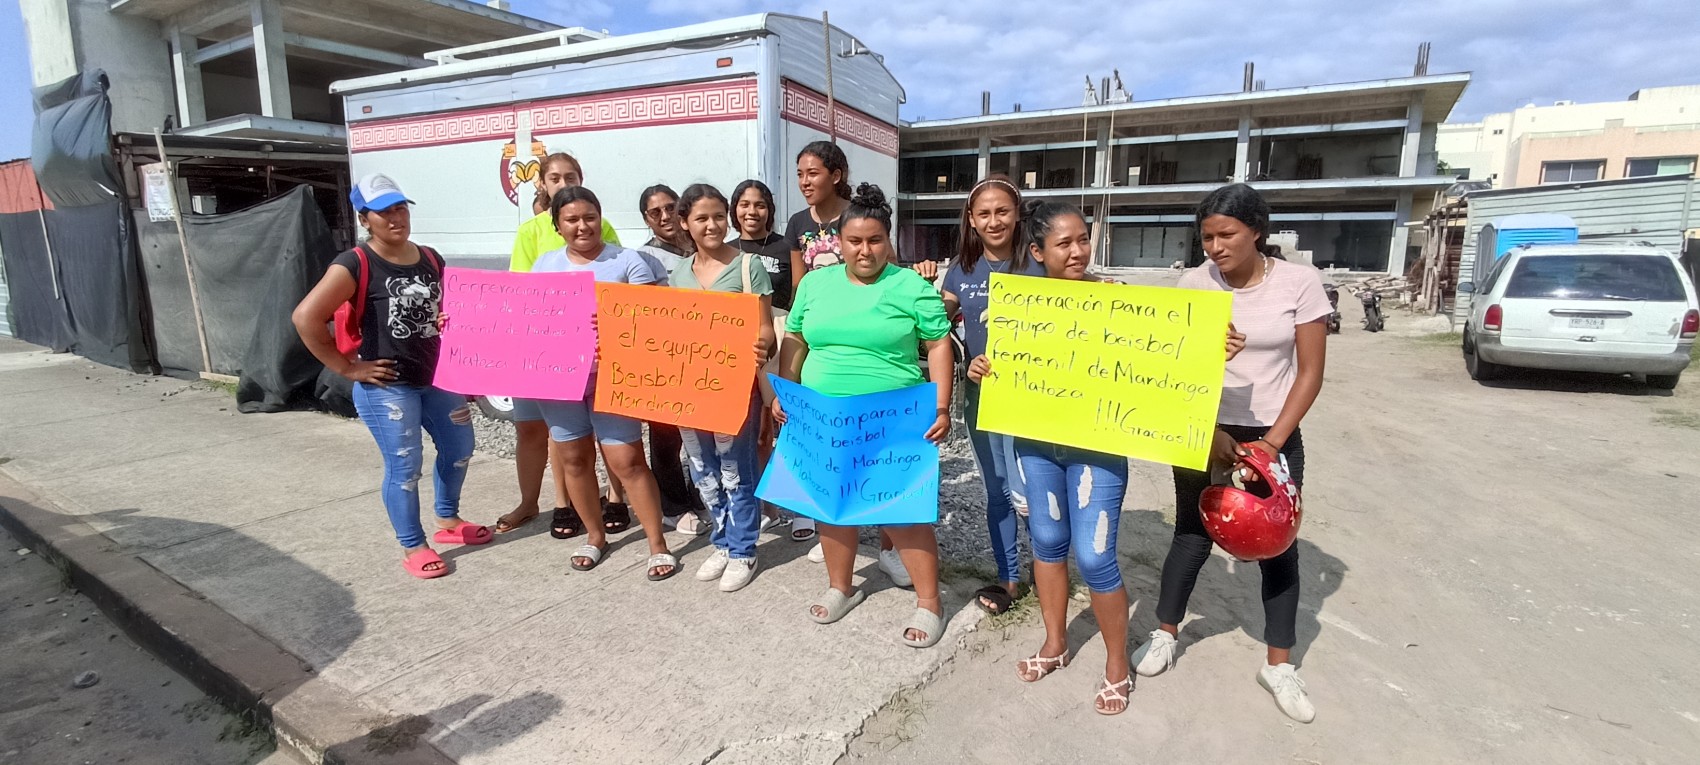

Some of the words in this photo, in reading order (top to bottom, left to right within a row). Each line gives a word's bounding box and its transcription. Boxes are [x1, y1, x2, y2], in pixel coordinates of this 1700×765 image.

[600, 289, 704, 324] Cooperación
[710, 312, 745, 330] para
[991, 281, 1103, 315] Cooperación
[1110, 299, 1156, 318] para
[1167, 302, 1192, 327] el
[618, 323, 637, 348] el
[645, 337, 712, 365] equipo
[715, 343, 738, 368] de
[993, 316, 1056, 341] equipo
[1066, 320, 1088, 342] de
[1104, 327, 1185, 360] beisbol
[450, 345, 508, 369] Matoza
[612, 362, 685, 388] Beisbol
[695, 368, 724, 391] de
[1014, 371, 1084, 400] Matoza
[1088, 357, 1109, 378] de
[1114, 361, 1209, 401] Mandinga
[611, 390, 696, 423] Mandinga
[858, 407, 897, 430] para
[904, 400, 918, 416] el
[831, 427, 885, 448] beisbol
[826, 457, 841, 474] de
[853, 451, 921, 472] Mandinga
